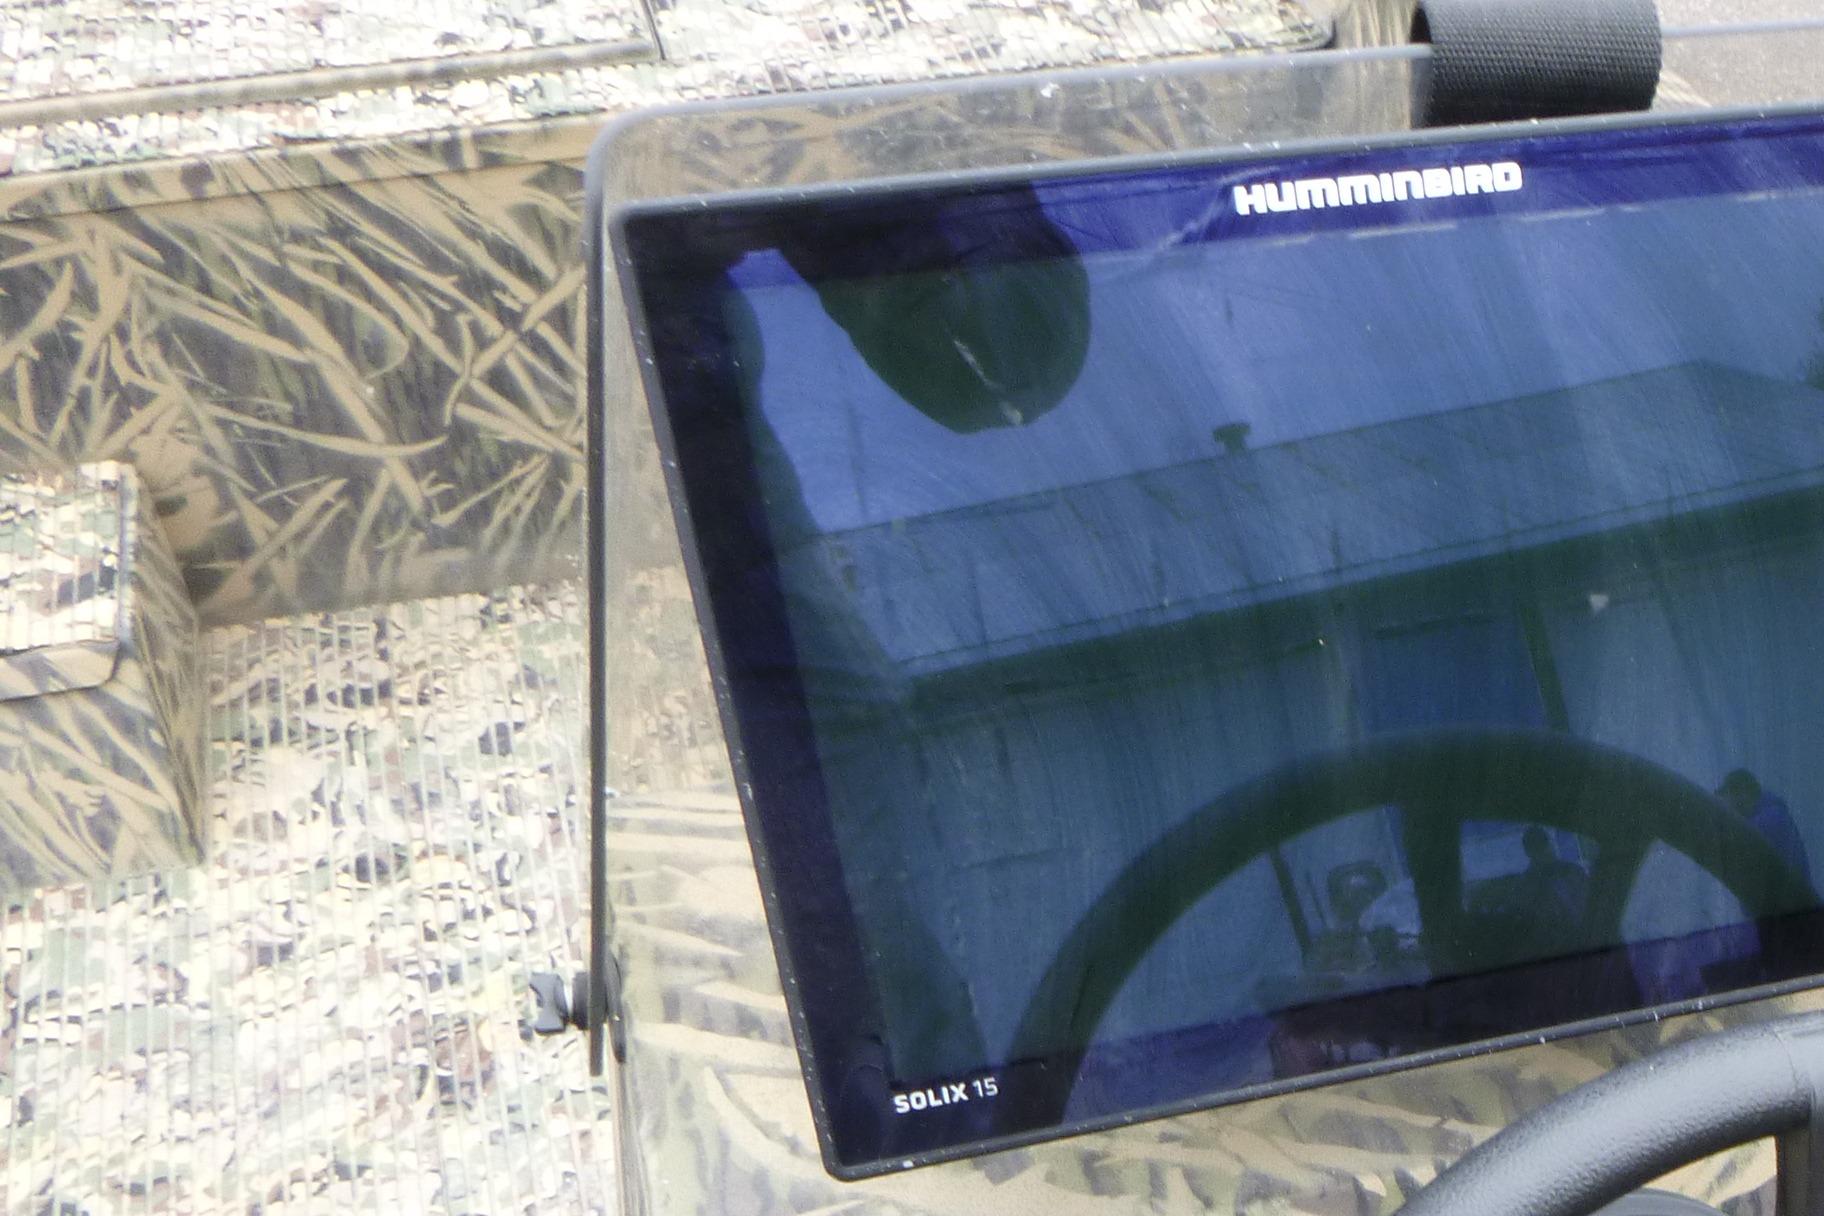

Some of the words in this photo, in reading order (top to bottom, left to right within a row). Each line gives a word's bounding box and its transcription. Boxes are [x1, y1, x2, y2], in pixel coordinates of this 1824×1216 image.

[1233, 162, 1523, 215] HUMMINBIRD
[894, 1083, 969, 1114] SOLIX
[972, 1076, 999, 1098] 15
